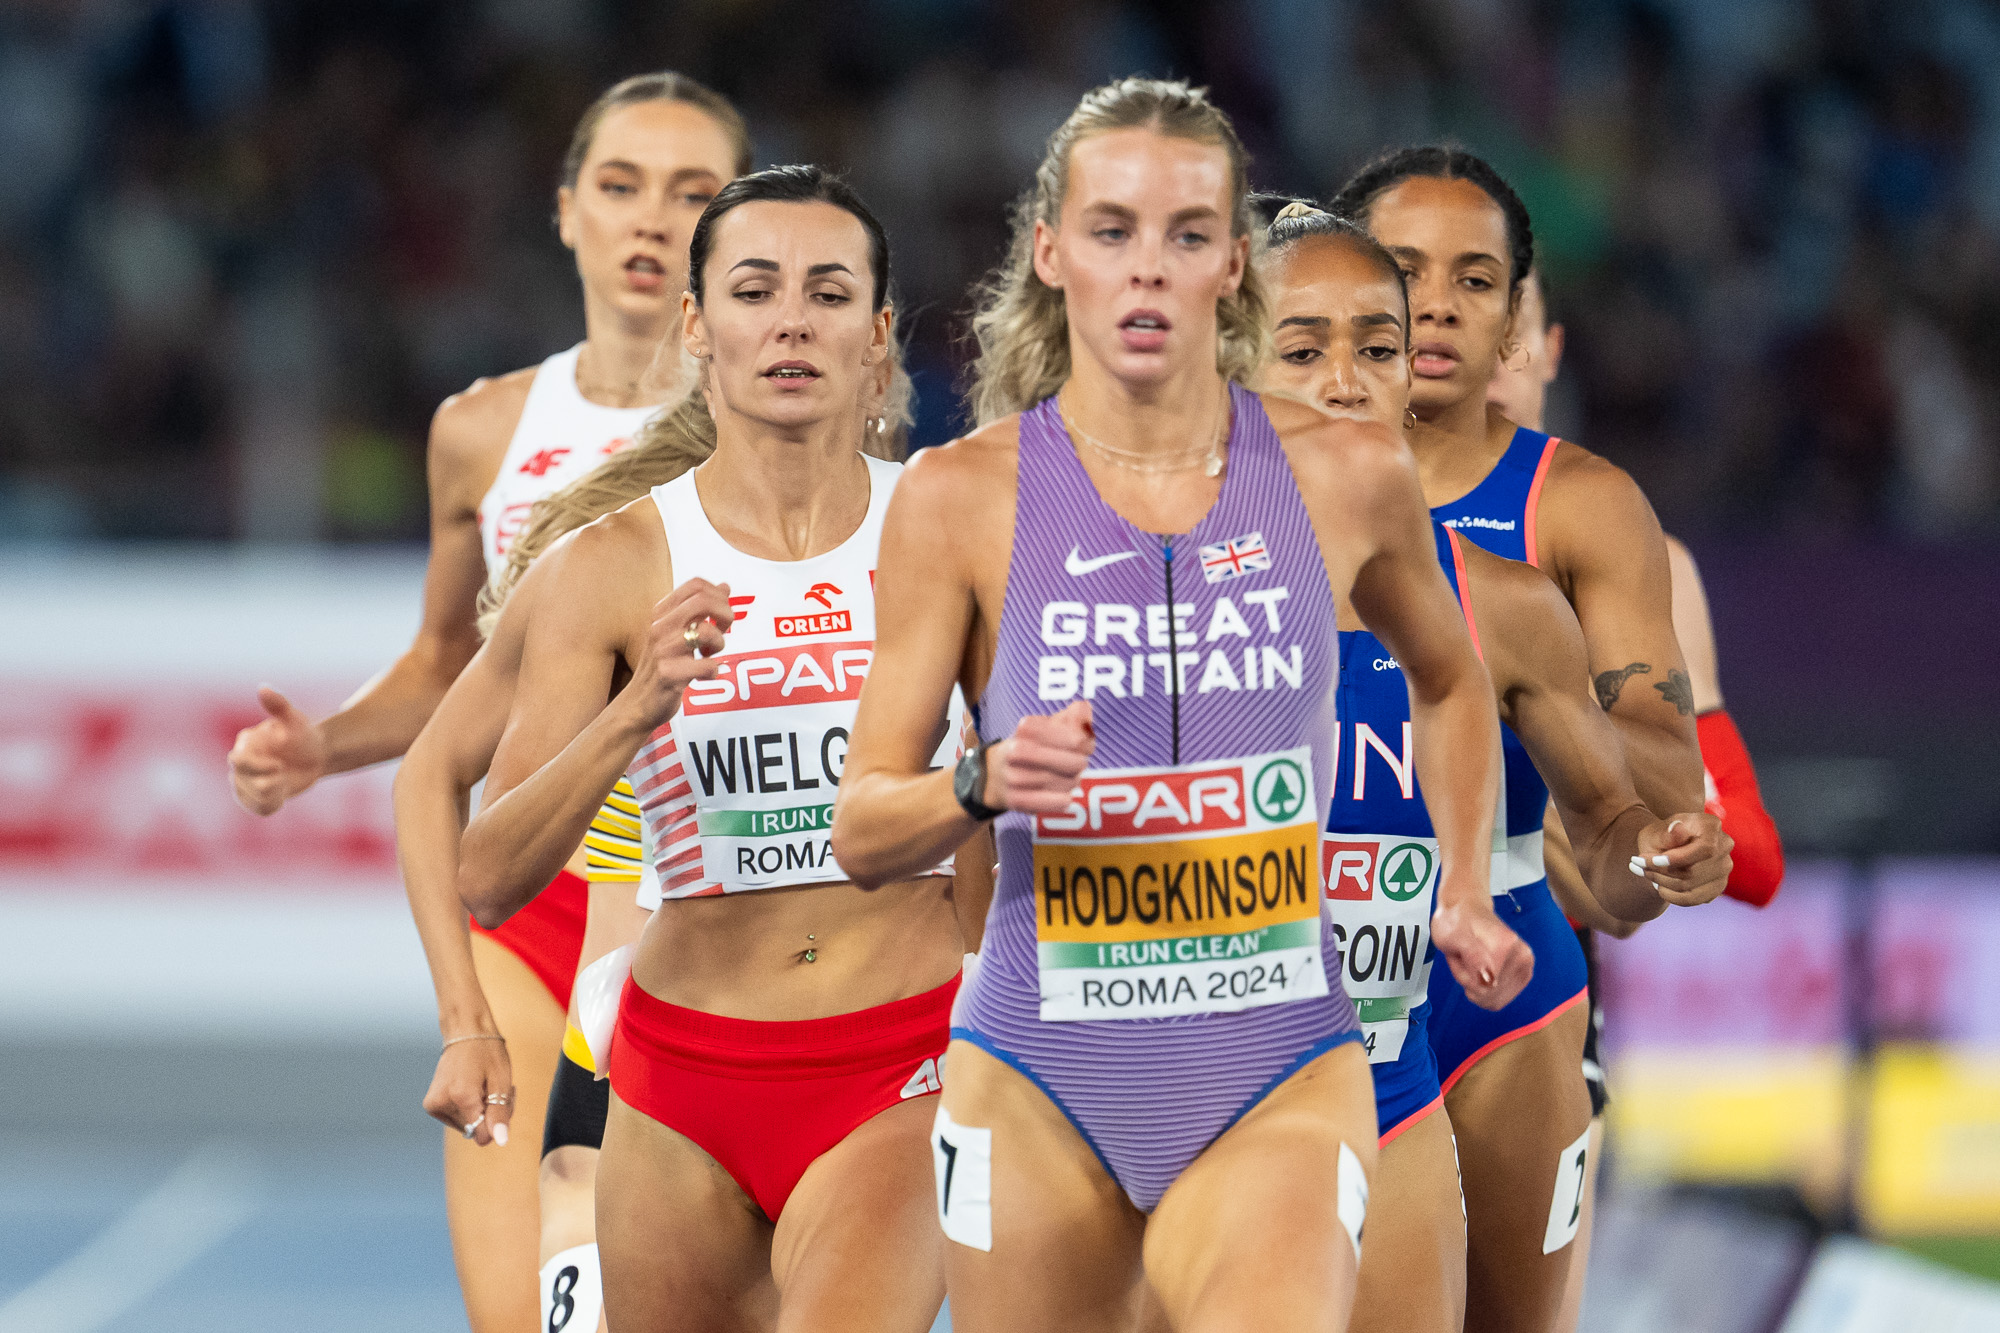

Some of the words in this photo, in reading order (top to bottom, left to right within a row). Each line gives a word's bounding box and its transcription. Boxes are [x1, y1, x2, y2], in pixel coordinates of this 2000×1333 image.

[1472, 517, 1516, 531] Mutuel
[778, 613, 848, 635] ORLEN
[1041, 586, 1290, 647] GREAT
[1038, 645, 1303, 701] BRITAIN
[763, 808, 818, 833] RUN
[1040, 774, 1242, 831] SPAR
[1042, 845, 1307, 927] HODGKINSON
[1098, 944, 1105, 966] I
[1110, 940, 1170, 965] RUN
[1082, 975, 1197, 1008] ROMA
[1207, 962, 1288, 999] 2024
[549, 1265, 579, 1333] 8
